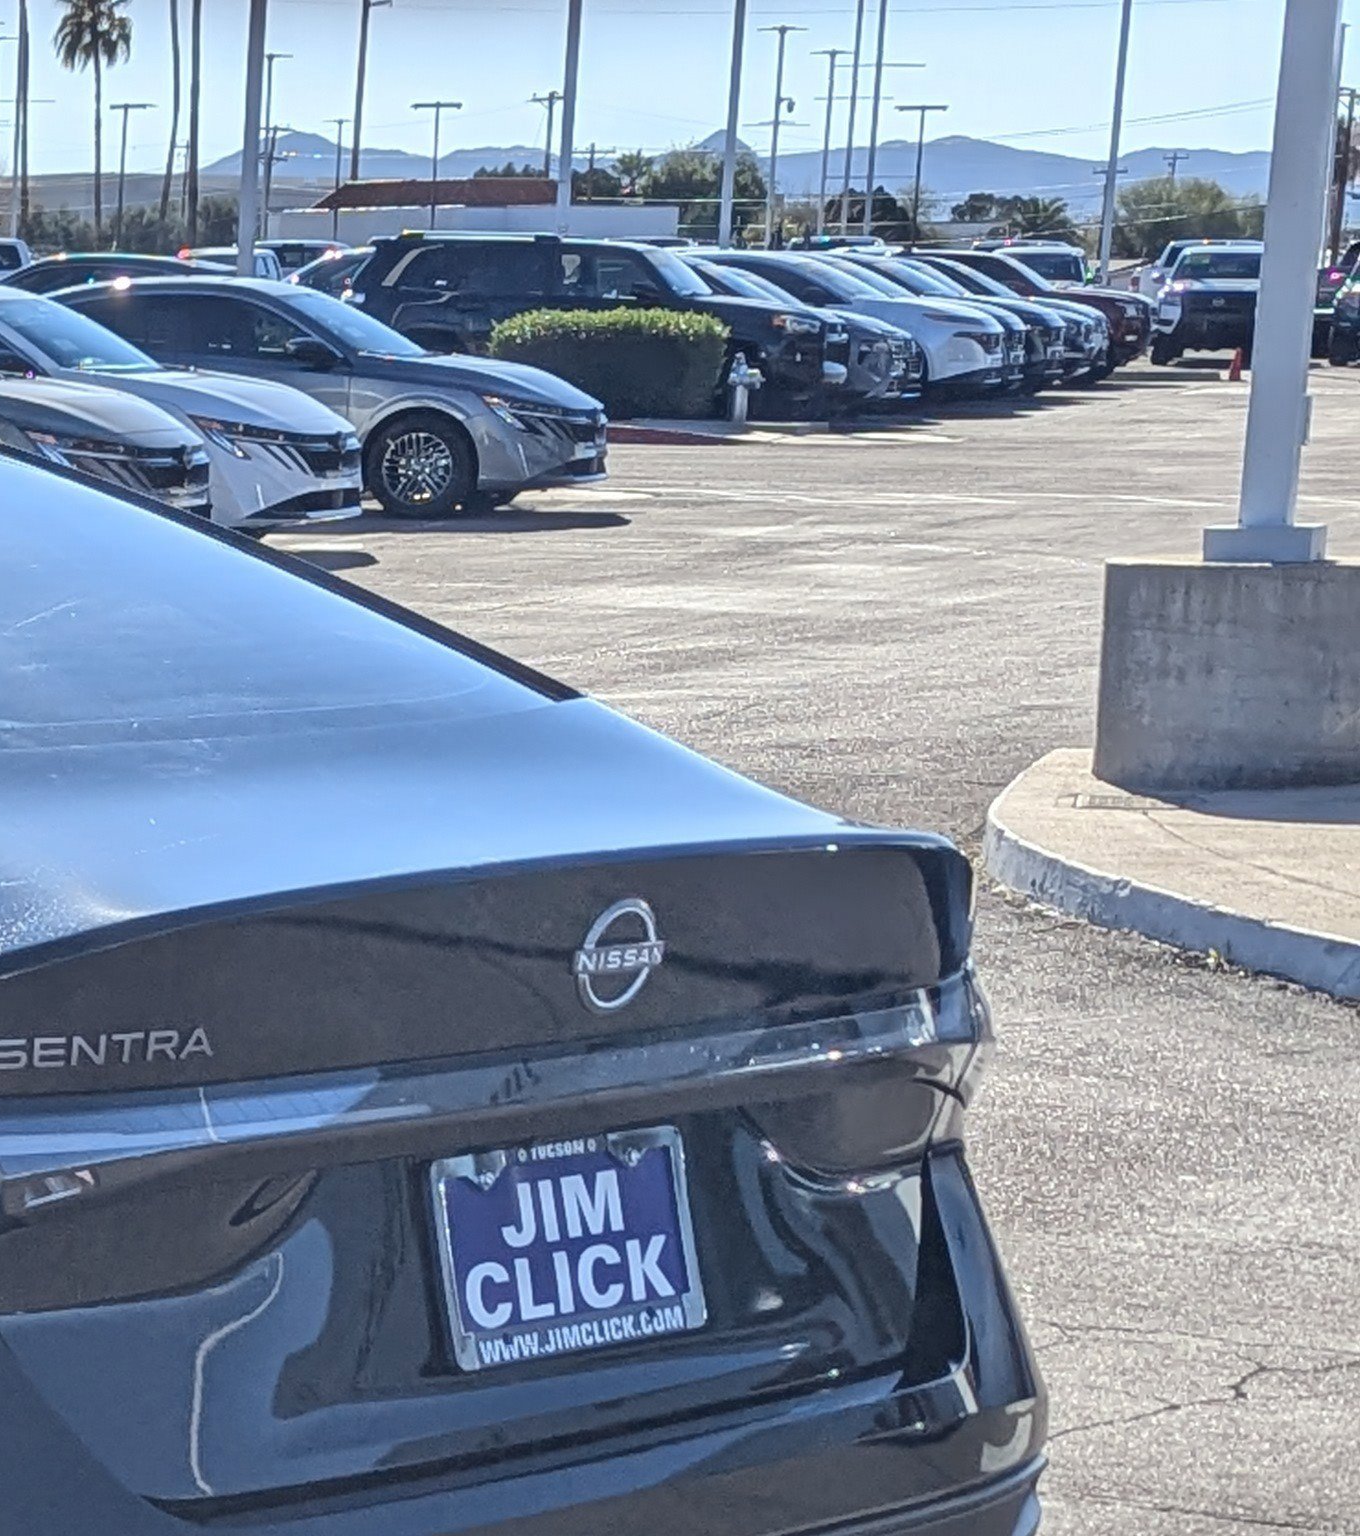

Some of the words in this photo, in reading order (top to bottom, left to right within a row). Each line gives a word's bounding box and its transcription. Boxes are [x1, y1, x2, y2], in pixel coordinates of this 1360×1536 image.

[575, 946, 662, 971] NISSAN
[530, 1138, 585, 1161] TUCSON
[501, 1169, 625, 1248] JIM
[465, 1234, 676, 1329] CLICK
[479, 1305, 685, 1364] WWW.JIMCLICK.COM
